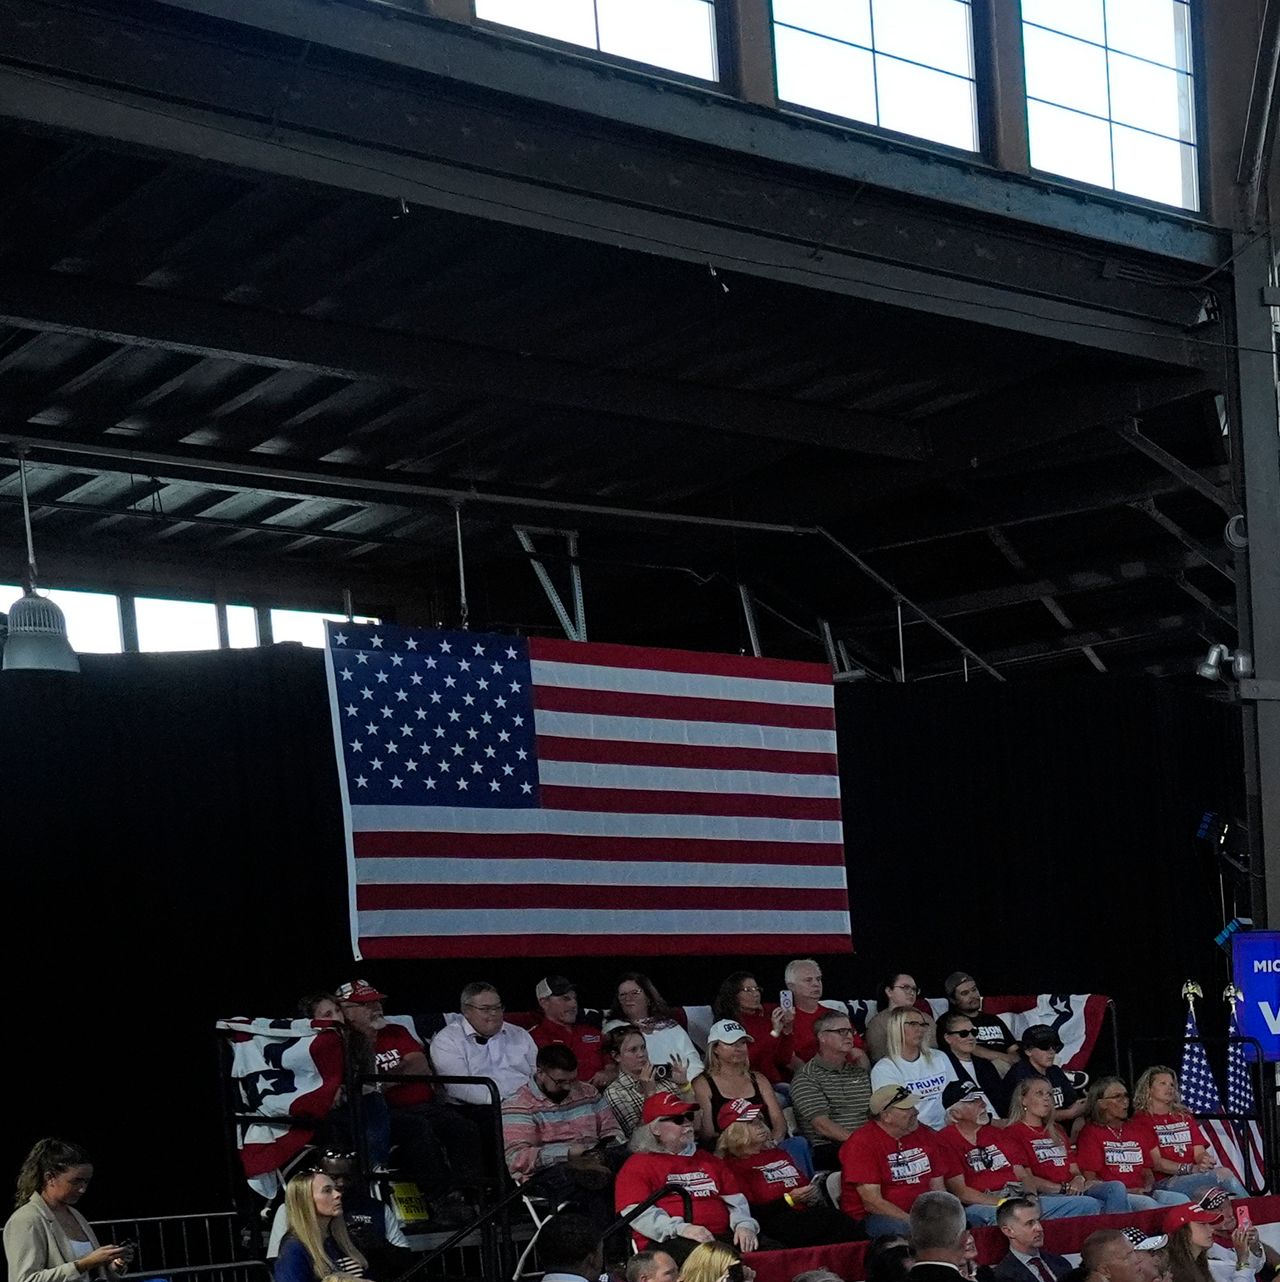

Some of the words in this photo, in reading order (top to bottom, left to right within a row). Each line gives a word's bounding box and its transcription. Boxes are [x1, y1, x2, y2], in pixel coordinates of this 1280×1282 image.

[909, 1075, 946, 1091] TRUMP
[921, 1086, 942, 1095] VANCE
[1159, 1132, 1192, 1146] TRUMP
[1036, 1147, 1068, 1160] TRUMP
[1106, 1151, 1142, 1164] TRUMP
[891, 1159, 932, 1180] TRUMP
[1119, 1164, 1134, 1173] 2024
